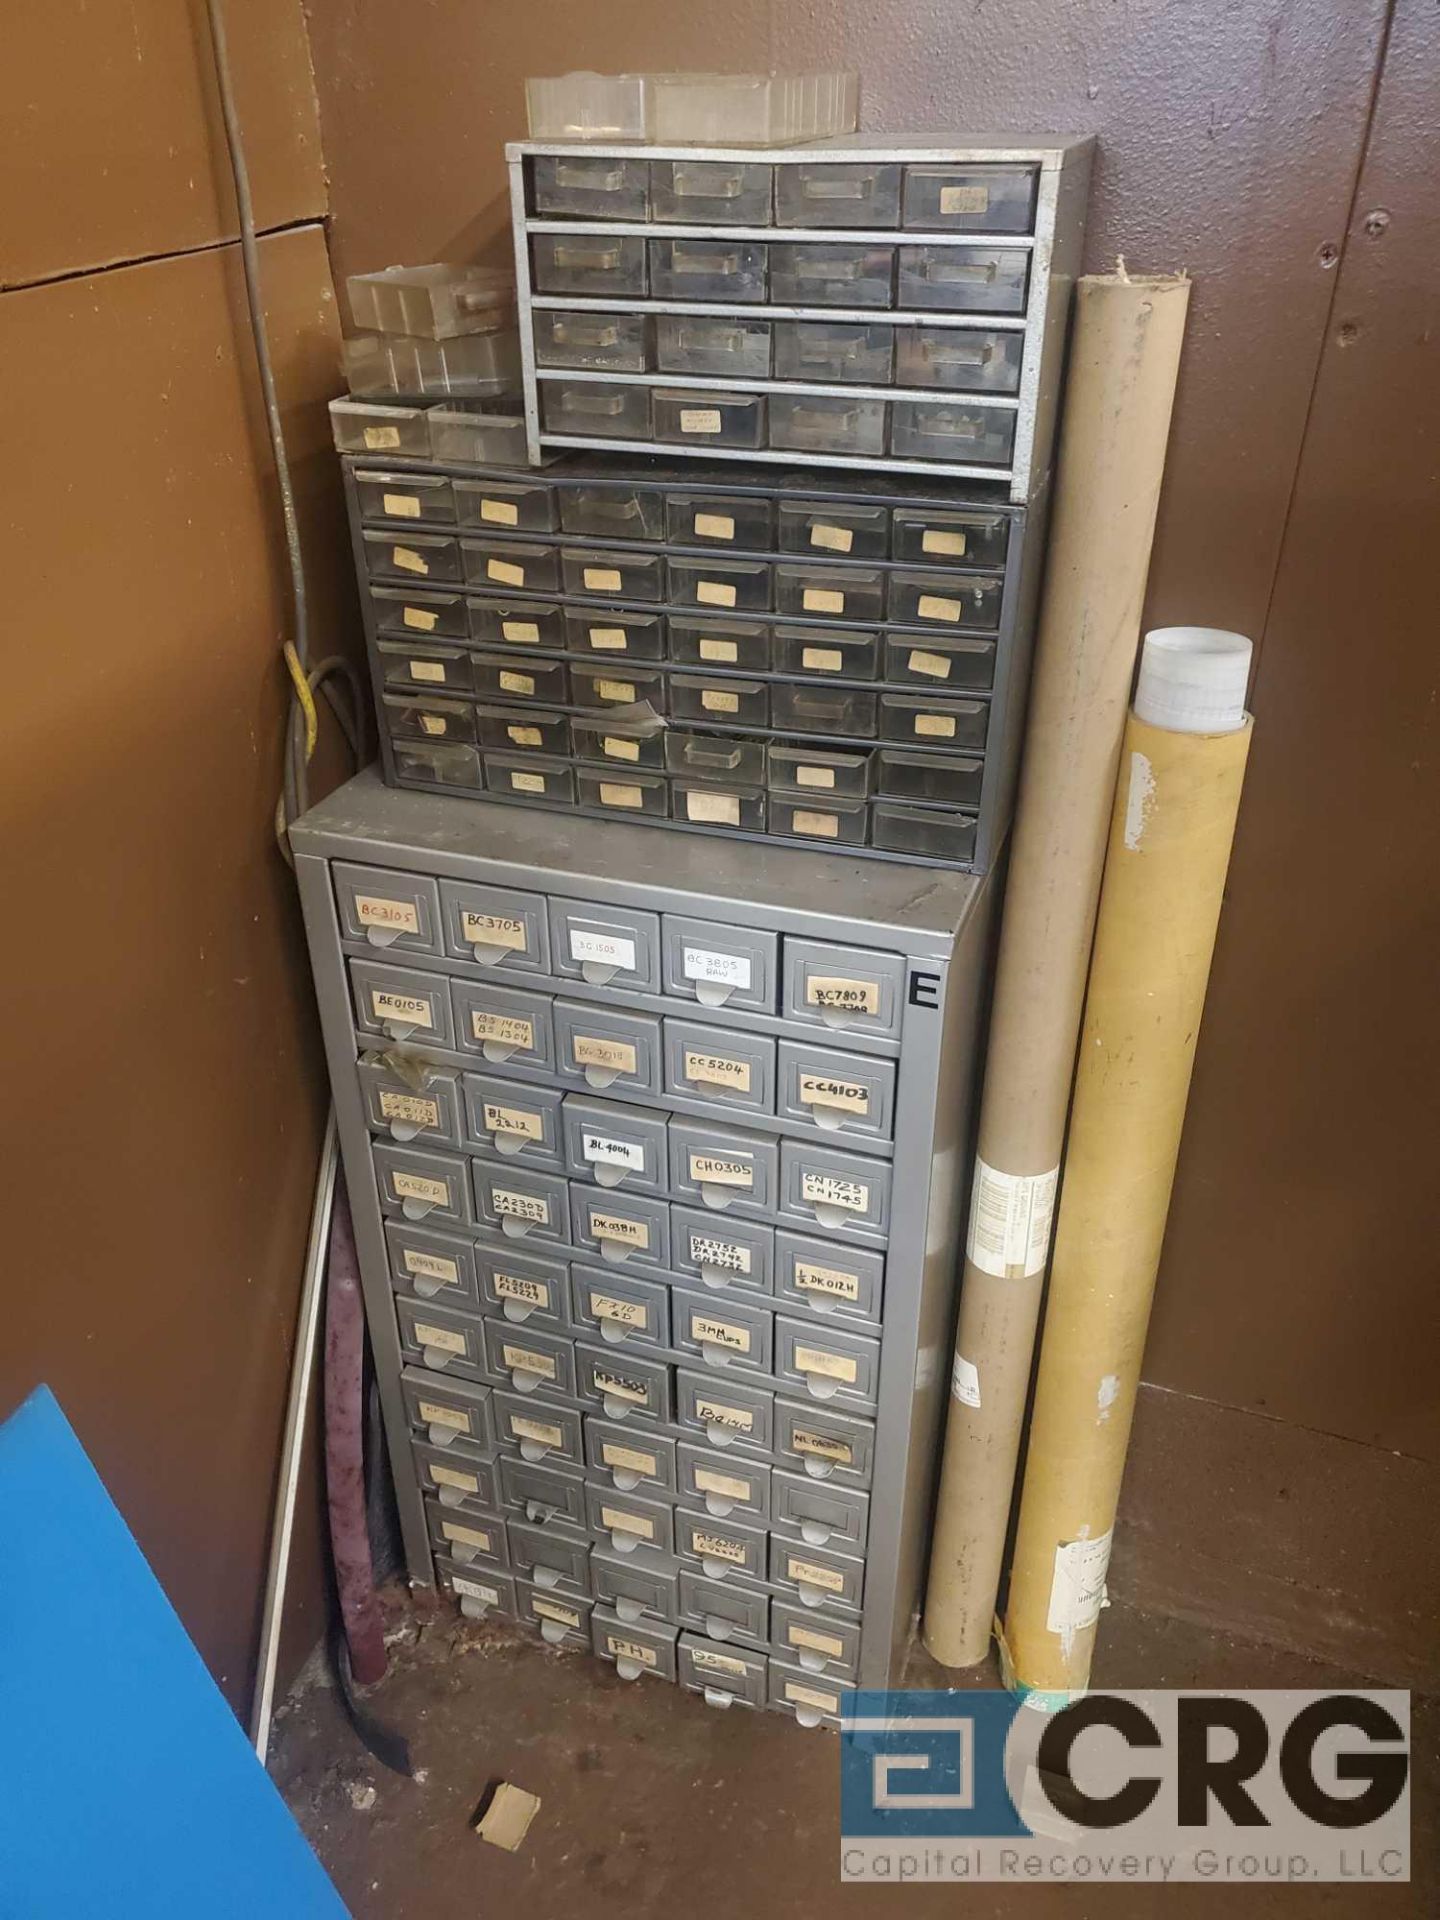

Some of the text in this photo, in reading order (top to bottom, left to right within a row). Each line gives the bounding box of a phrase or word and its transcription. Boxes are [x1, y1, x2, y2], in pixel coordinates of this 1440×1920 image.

[361, 904, 414, 923] BC3105
[467, 913, 522, 933] BC3705
[908, 971, 941, 1010] E
[804, 1081, 869, 1100] CC4103
[696, 1159, 752, 1176] CH0305
